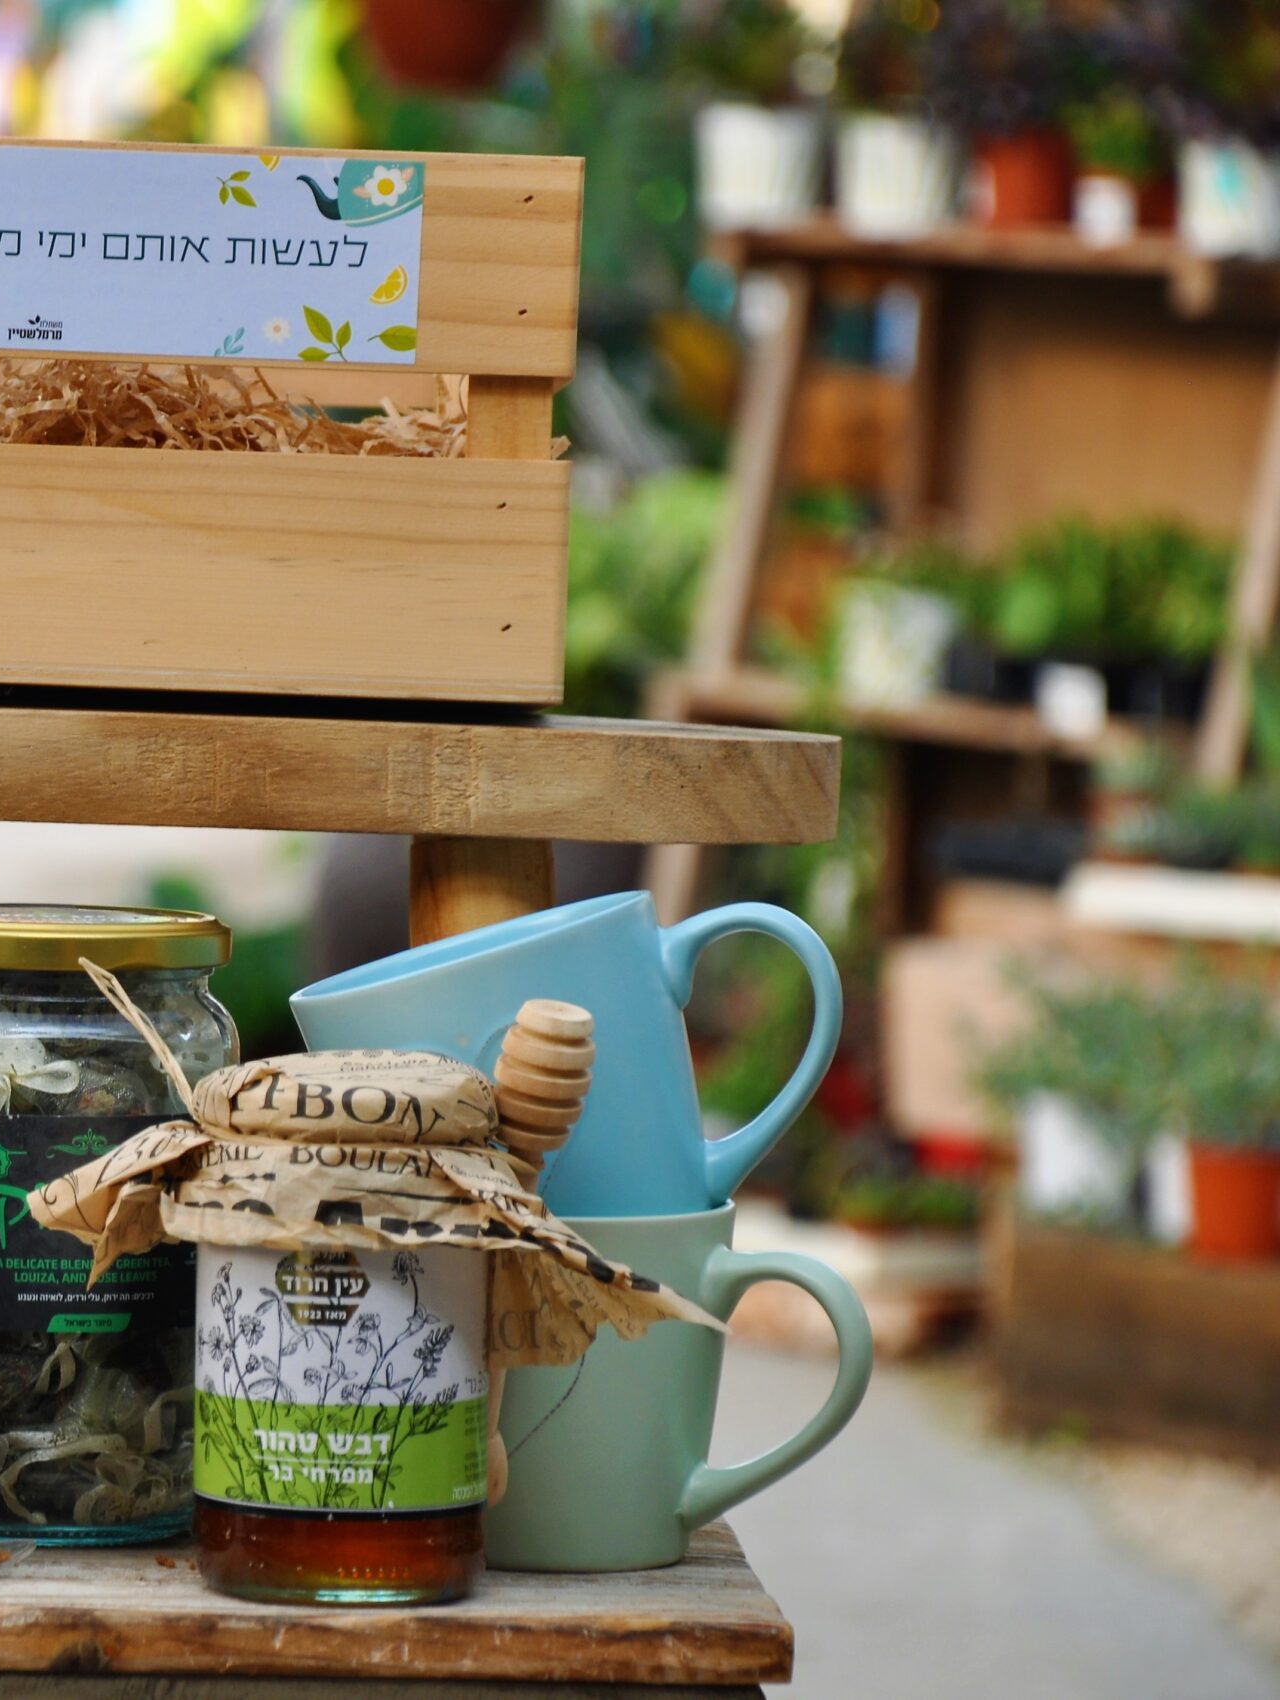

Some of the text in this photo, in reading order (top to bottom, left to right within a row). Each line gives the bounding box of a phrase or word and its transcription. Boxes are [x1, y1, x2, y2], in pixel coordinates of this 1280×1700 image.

[38, 230, 86, 258] ימי
[102, 233, 210, 263] אותם
[224, 234, 368, 268] לעשות
[8, 327, 62, 340] מרמלשטיין
[6, 1259, 57, 1269] DELICATE
[118, 1258, 150, 1269] GREEN
[14, 1271, 158, 1284] LOUIZA, AND OSE LEAVES
[282, 1276, 364, 1298] עין חרוד
[299, 1309, 347, 1320] מאז 1922
[254, 1429, 391, 1455] דבש טהור
[268, 1464, 373, 1483] מפרחי בר
